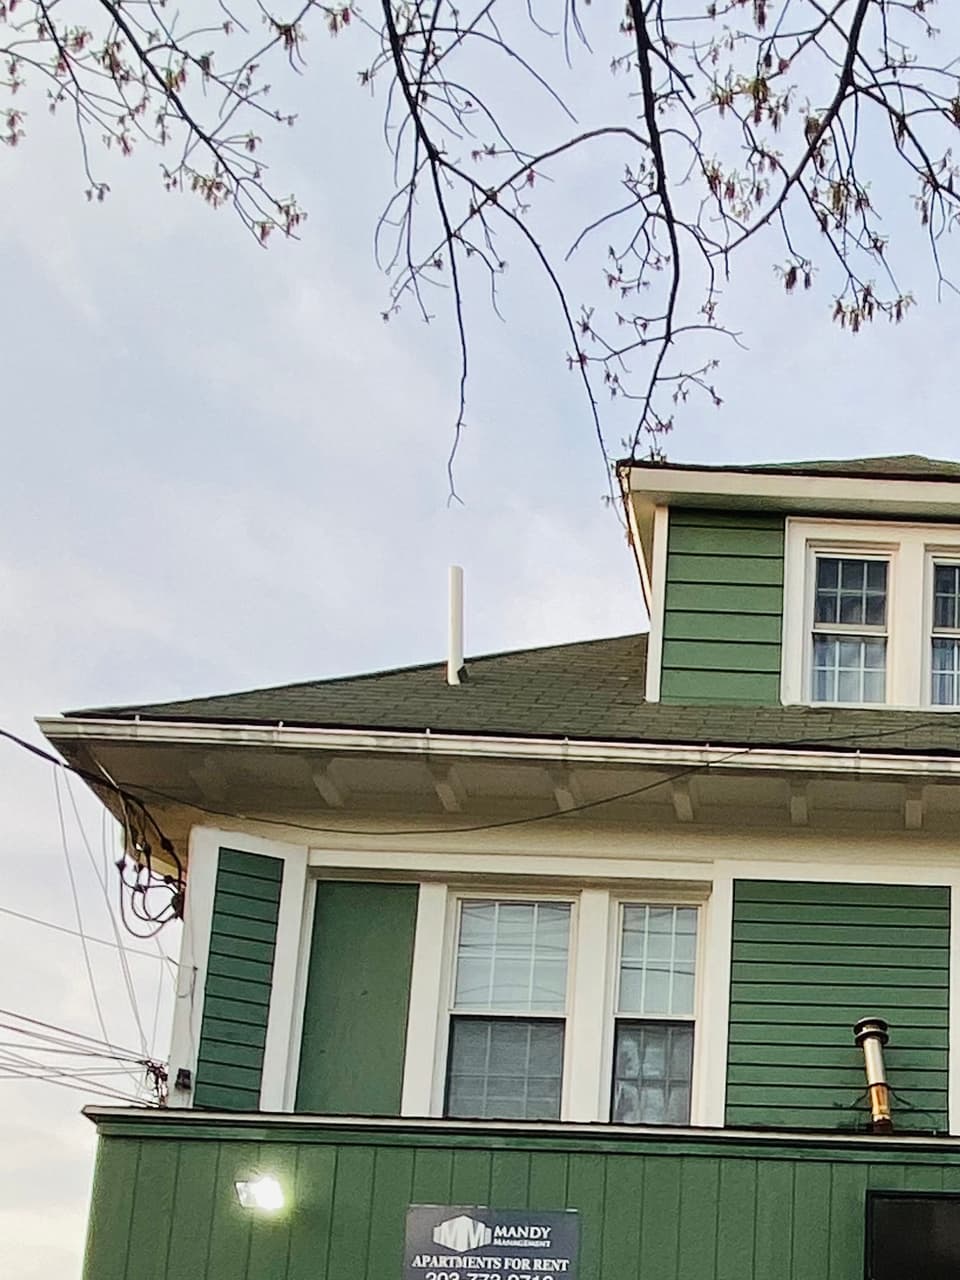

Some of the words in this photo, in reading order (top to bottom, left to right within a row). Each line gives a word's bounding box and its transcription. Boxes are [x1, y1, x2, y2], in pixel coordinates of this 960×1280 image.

[493, 1225, 551, 1239] MANDY
[412, 1255, 502, 1270] APARTMENTS
[504, 1257, 531, 1271] FOR
[533, 1259, 569, 1272] RENT
